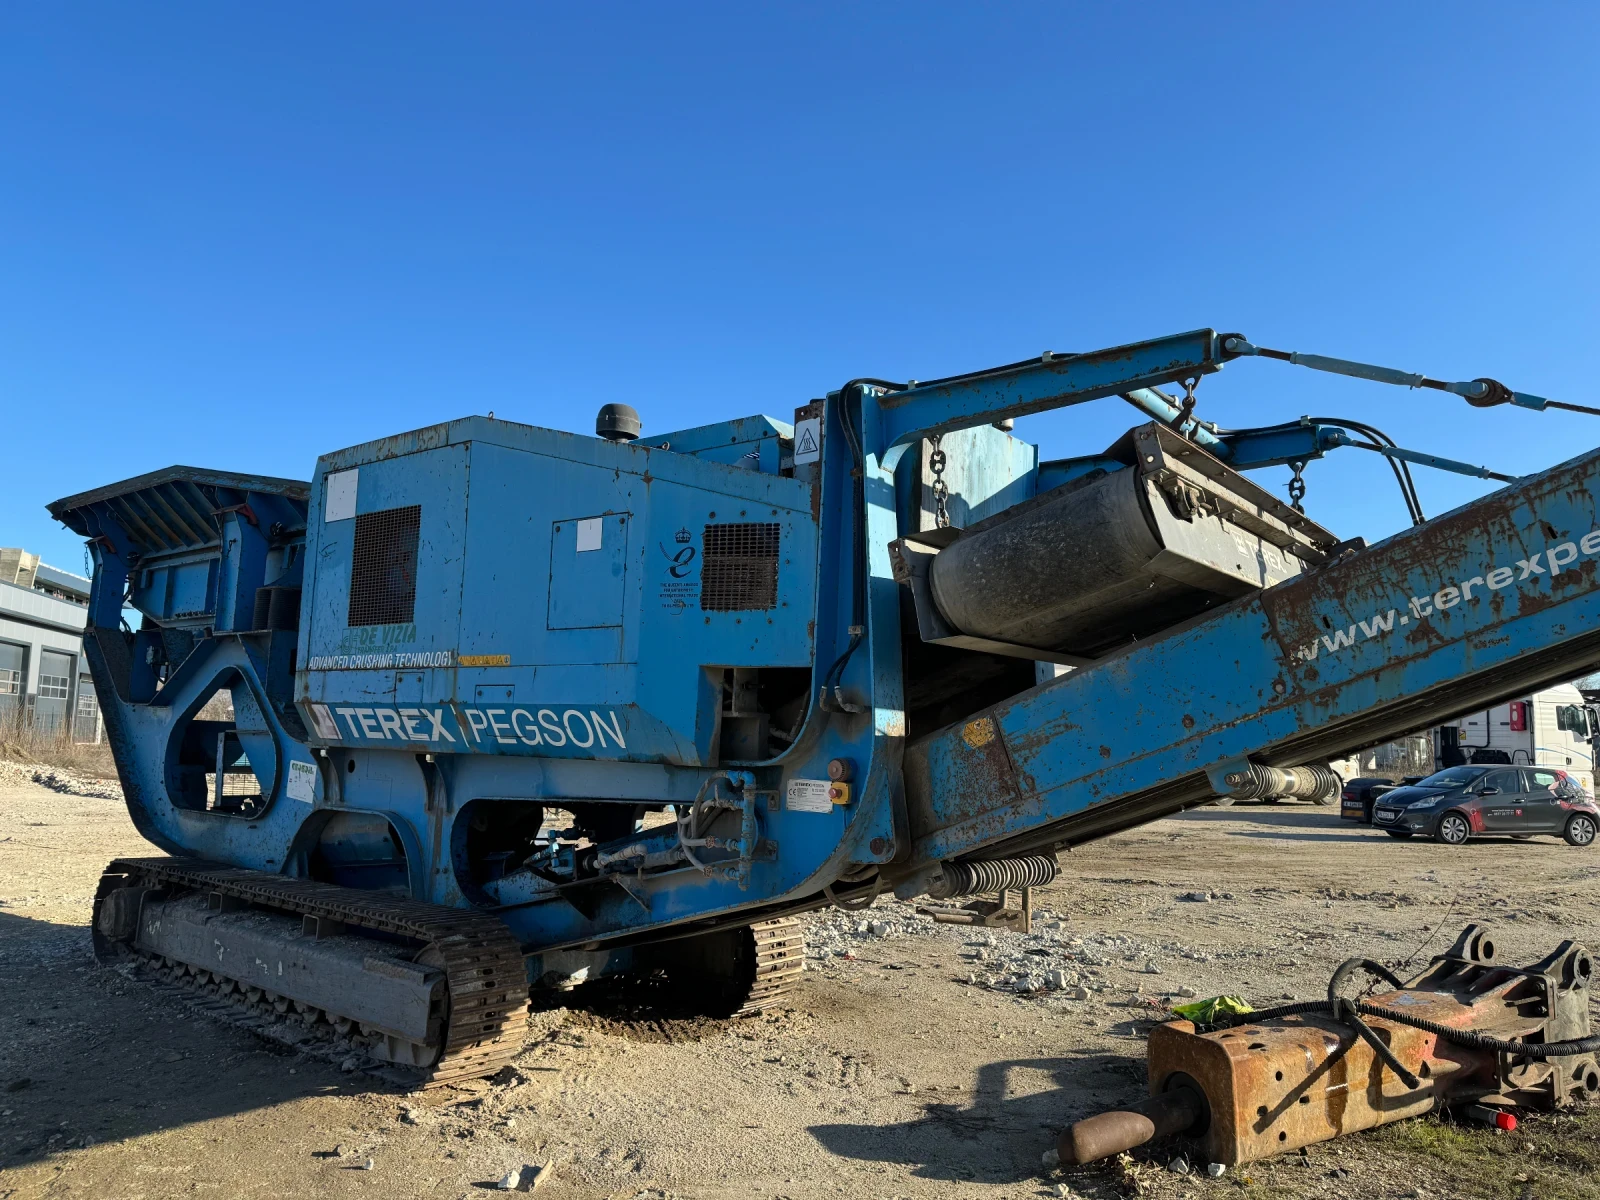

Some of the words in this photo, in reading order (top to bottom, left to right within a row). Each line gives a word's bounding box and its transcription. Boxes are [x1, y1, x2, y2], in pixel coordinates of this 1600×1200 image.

[359, 627, 378, 645] DE
[382, 624, 417, 645] VIZIA
[308, 655, 348, 670] ADVANCED
[350, 653, 393, 669] CRUSHING
[335, 707, 456, 743] TEREX
[464, 709, 627, 749] PEGSON
